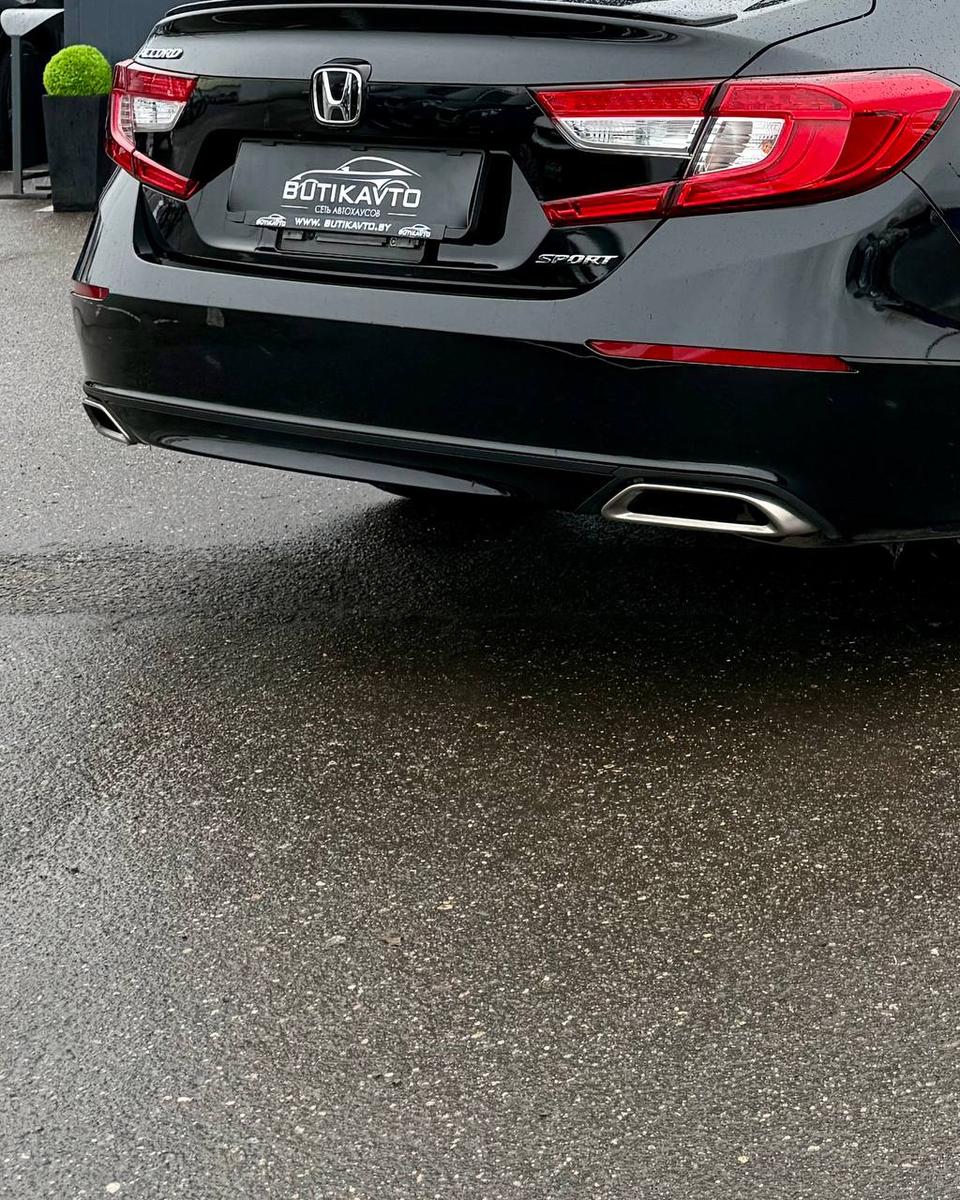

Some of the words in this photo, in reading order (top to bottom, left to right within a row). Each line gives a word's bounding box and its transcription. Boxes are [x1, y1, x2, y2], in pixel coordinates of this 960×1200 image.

[282, 180, 422, 208] BUTIKAVTO
[315, 205, 331, 214] СЕТЬ
[332, 206, 381, 218] АВТОХАУСОВ
[535, 253, 619, 265] SPORT
